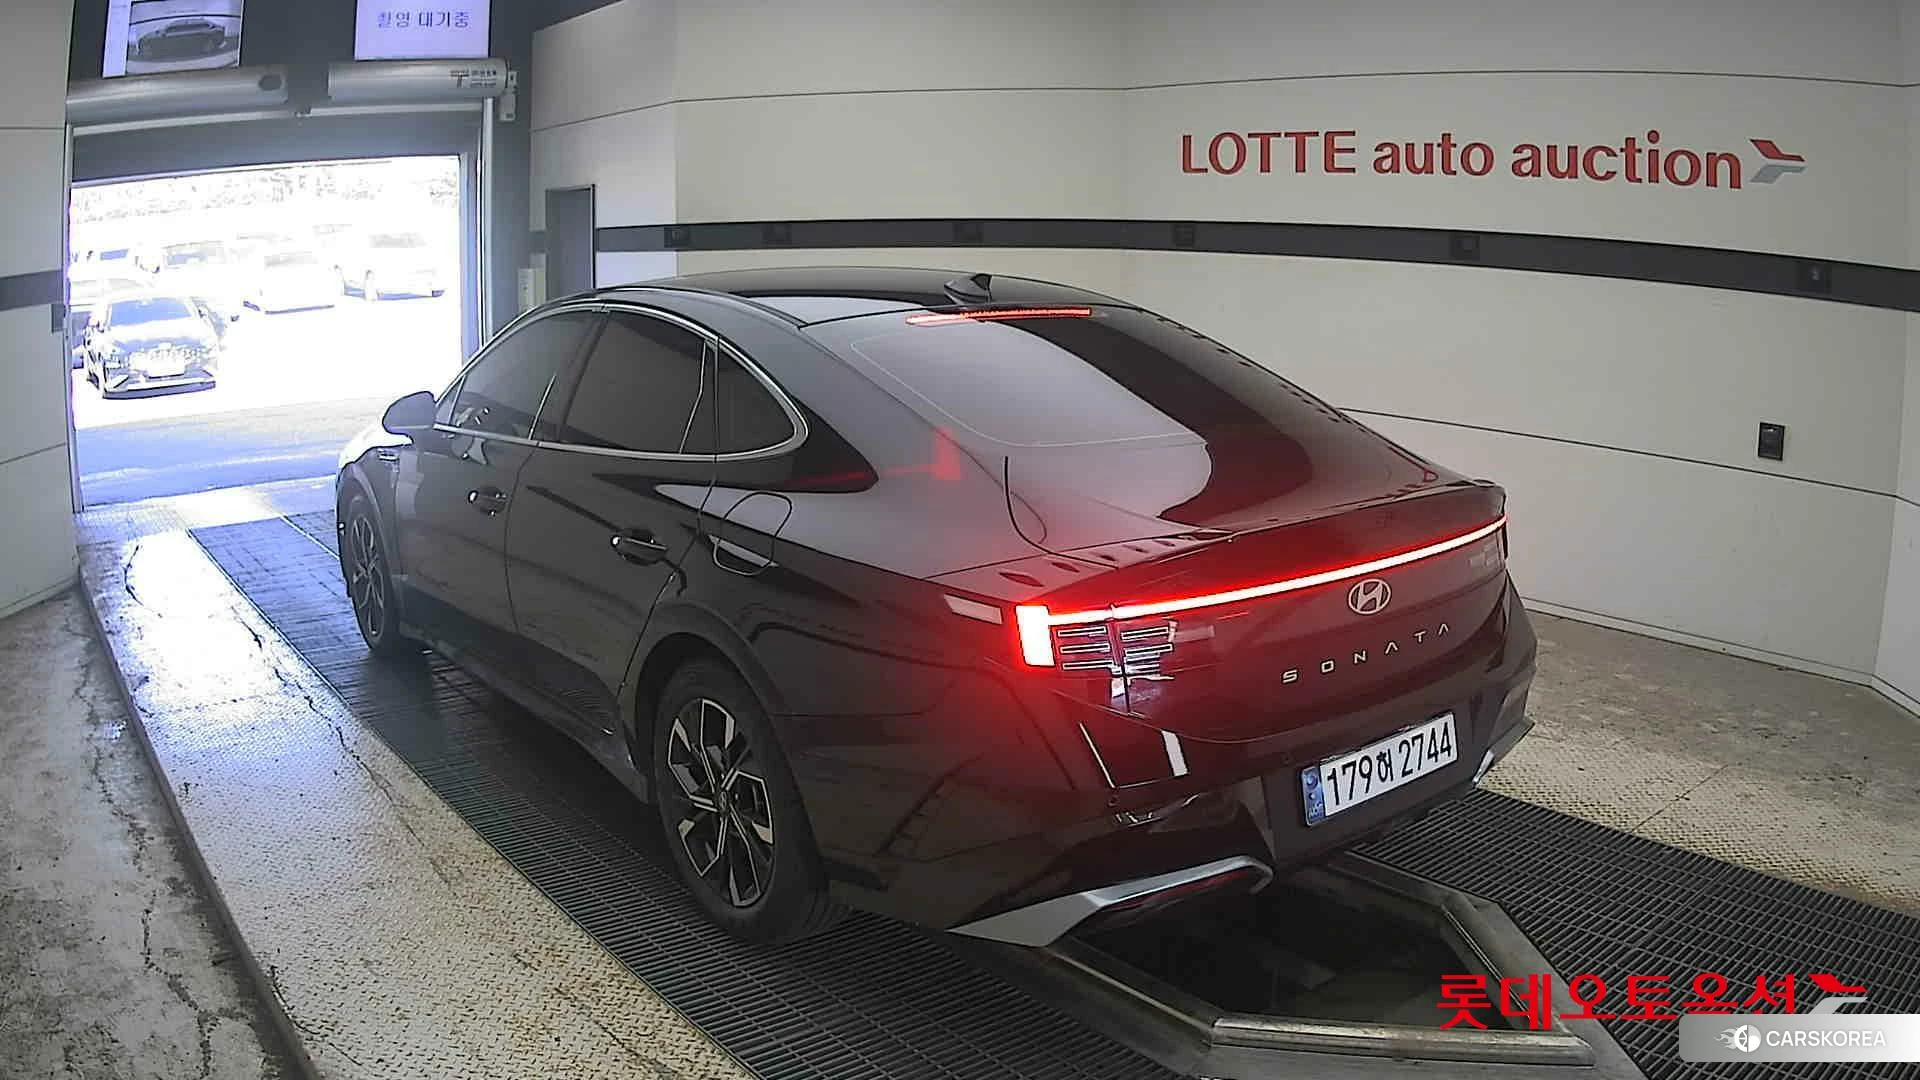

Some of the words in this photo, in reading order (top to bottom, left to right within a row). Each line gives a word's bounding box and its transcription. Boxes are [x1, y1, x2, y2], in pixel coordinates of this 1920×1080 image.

[418, 11, 470, 28] 대기중
[1182, 131, 1356, 175] LOTTE
[1373, 132, 1494, 176] auto
[1511, 130, 1742, 189] auction
[1282, 623, 1449, 684] SONATA
[1327, 748, 1394, 806] 179허
[1398, 722, 1451, 777] 2744
